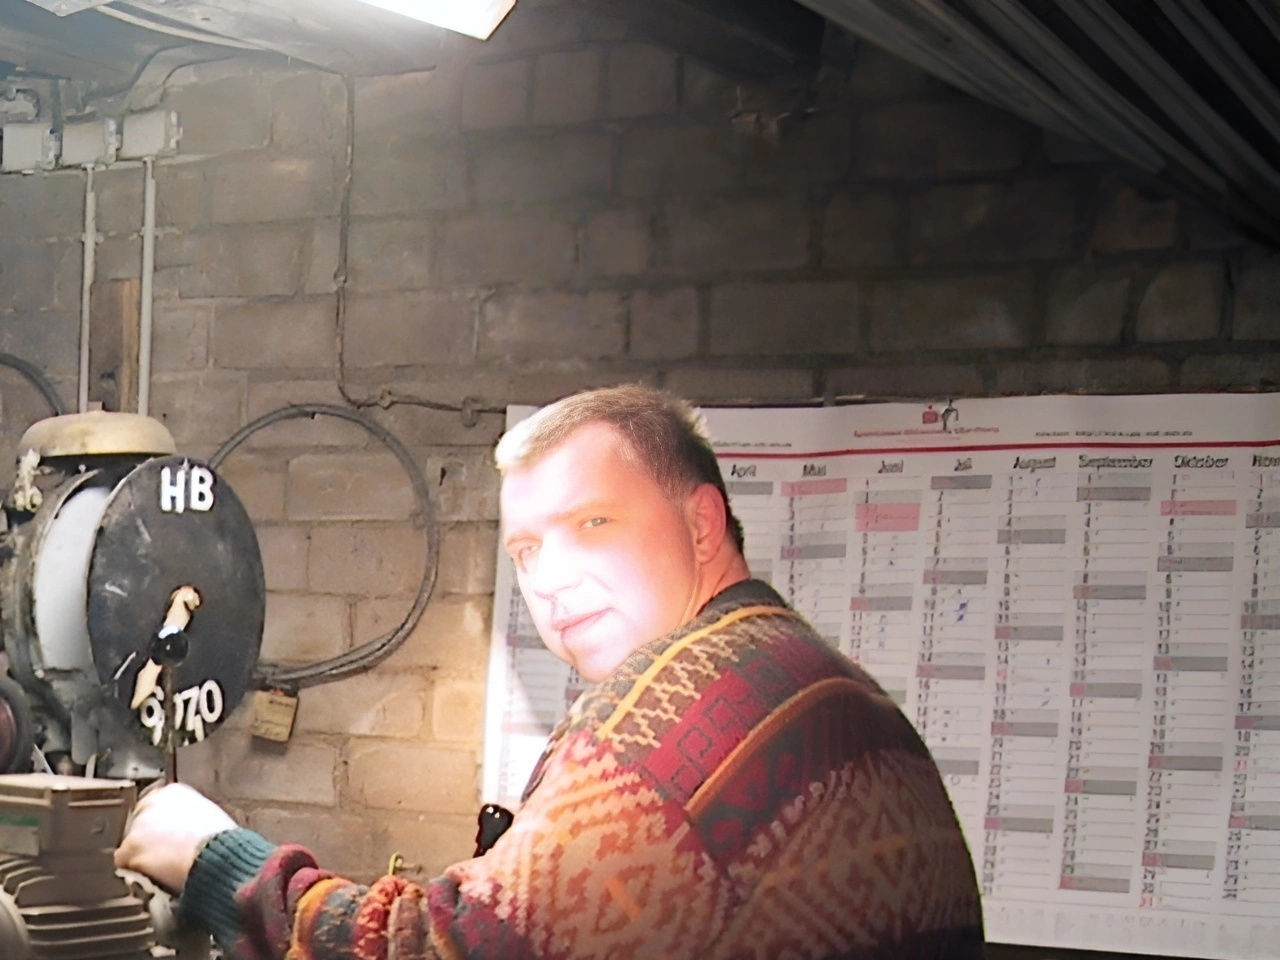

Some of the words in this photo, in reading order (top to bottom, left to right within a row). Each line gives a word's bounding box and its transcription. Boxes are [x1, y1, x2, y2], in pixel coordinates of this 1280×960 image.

[1078, 455, 1154, 473] September
[1174, 455, 1229, 469] Oktober
[161, 465, 214, 514] HB
